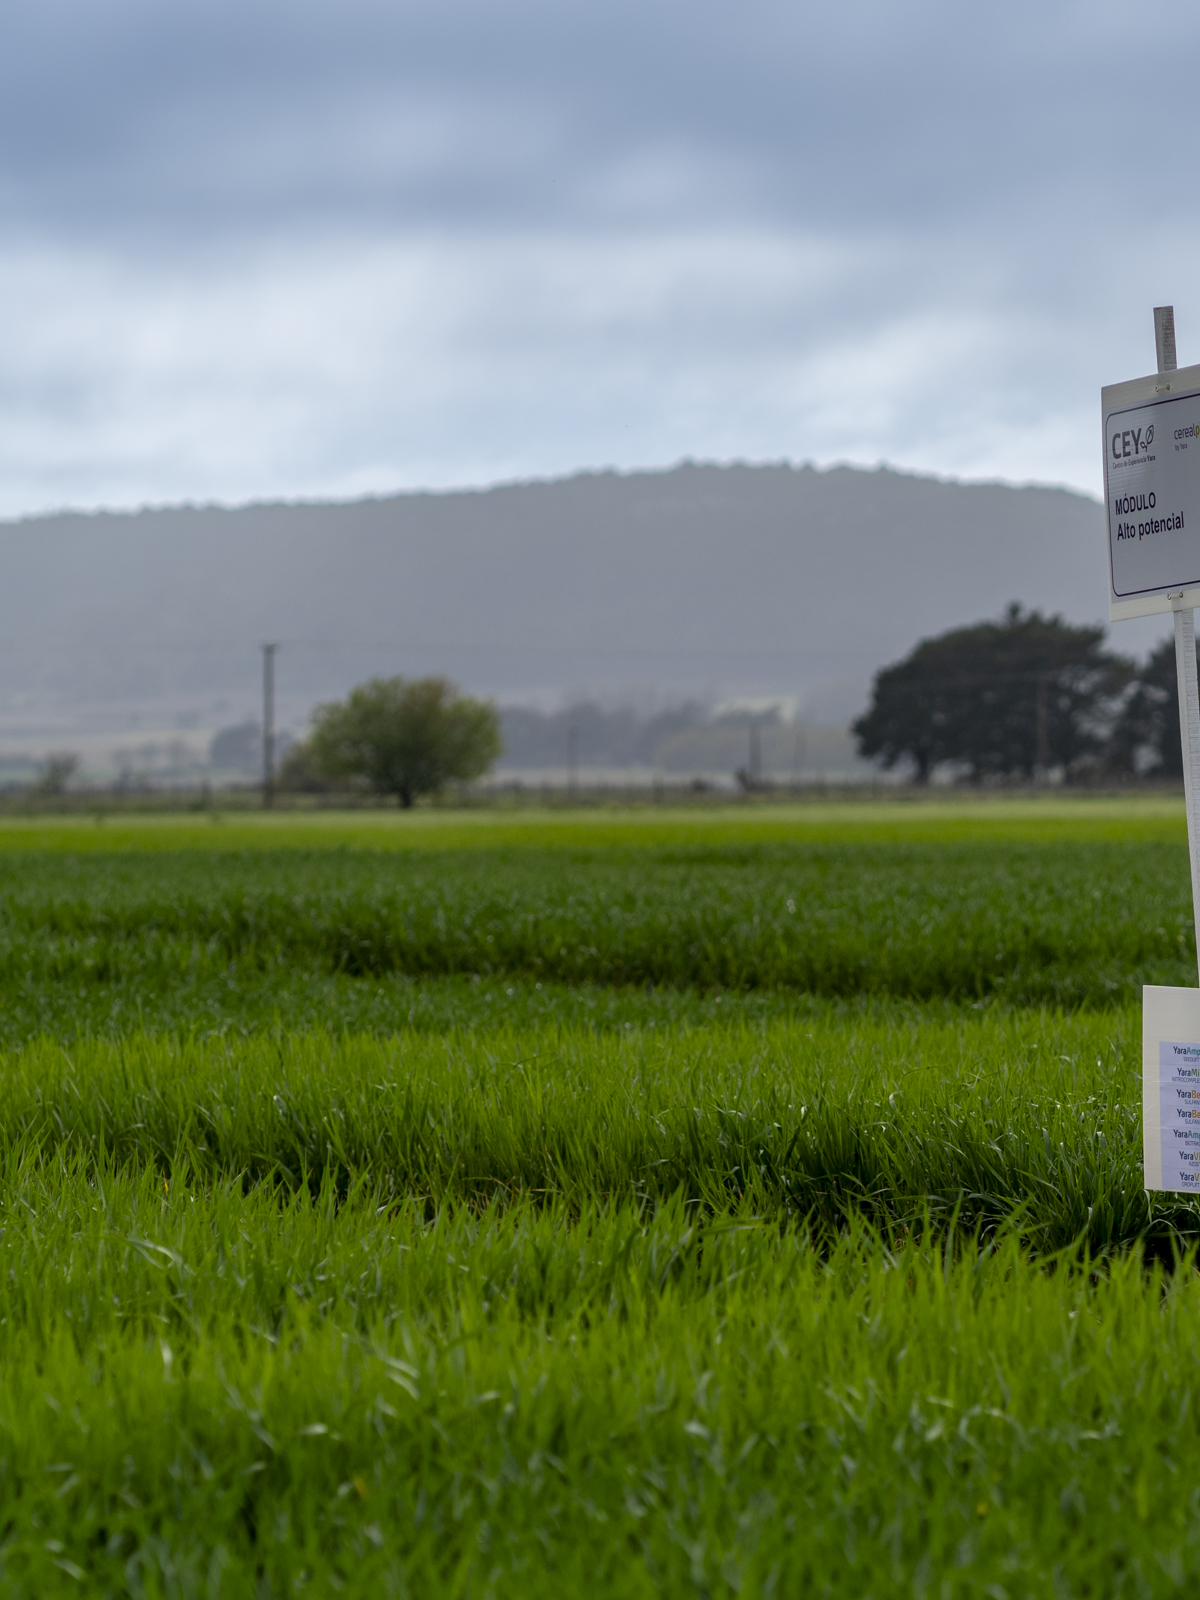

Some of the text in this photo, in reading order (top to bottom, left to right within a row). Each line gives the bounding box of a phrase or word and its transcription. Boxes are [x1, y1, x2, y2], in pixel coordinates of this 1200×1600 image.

[1112, 428, 1142, 459] CEY
[1115, 492, 1156, 516] MÓDULO
[1117, 511, 1184, 541] Alto potencial
